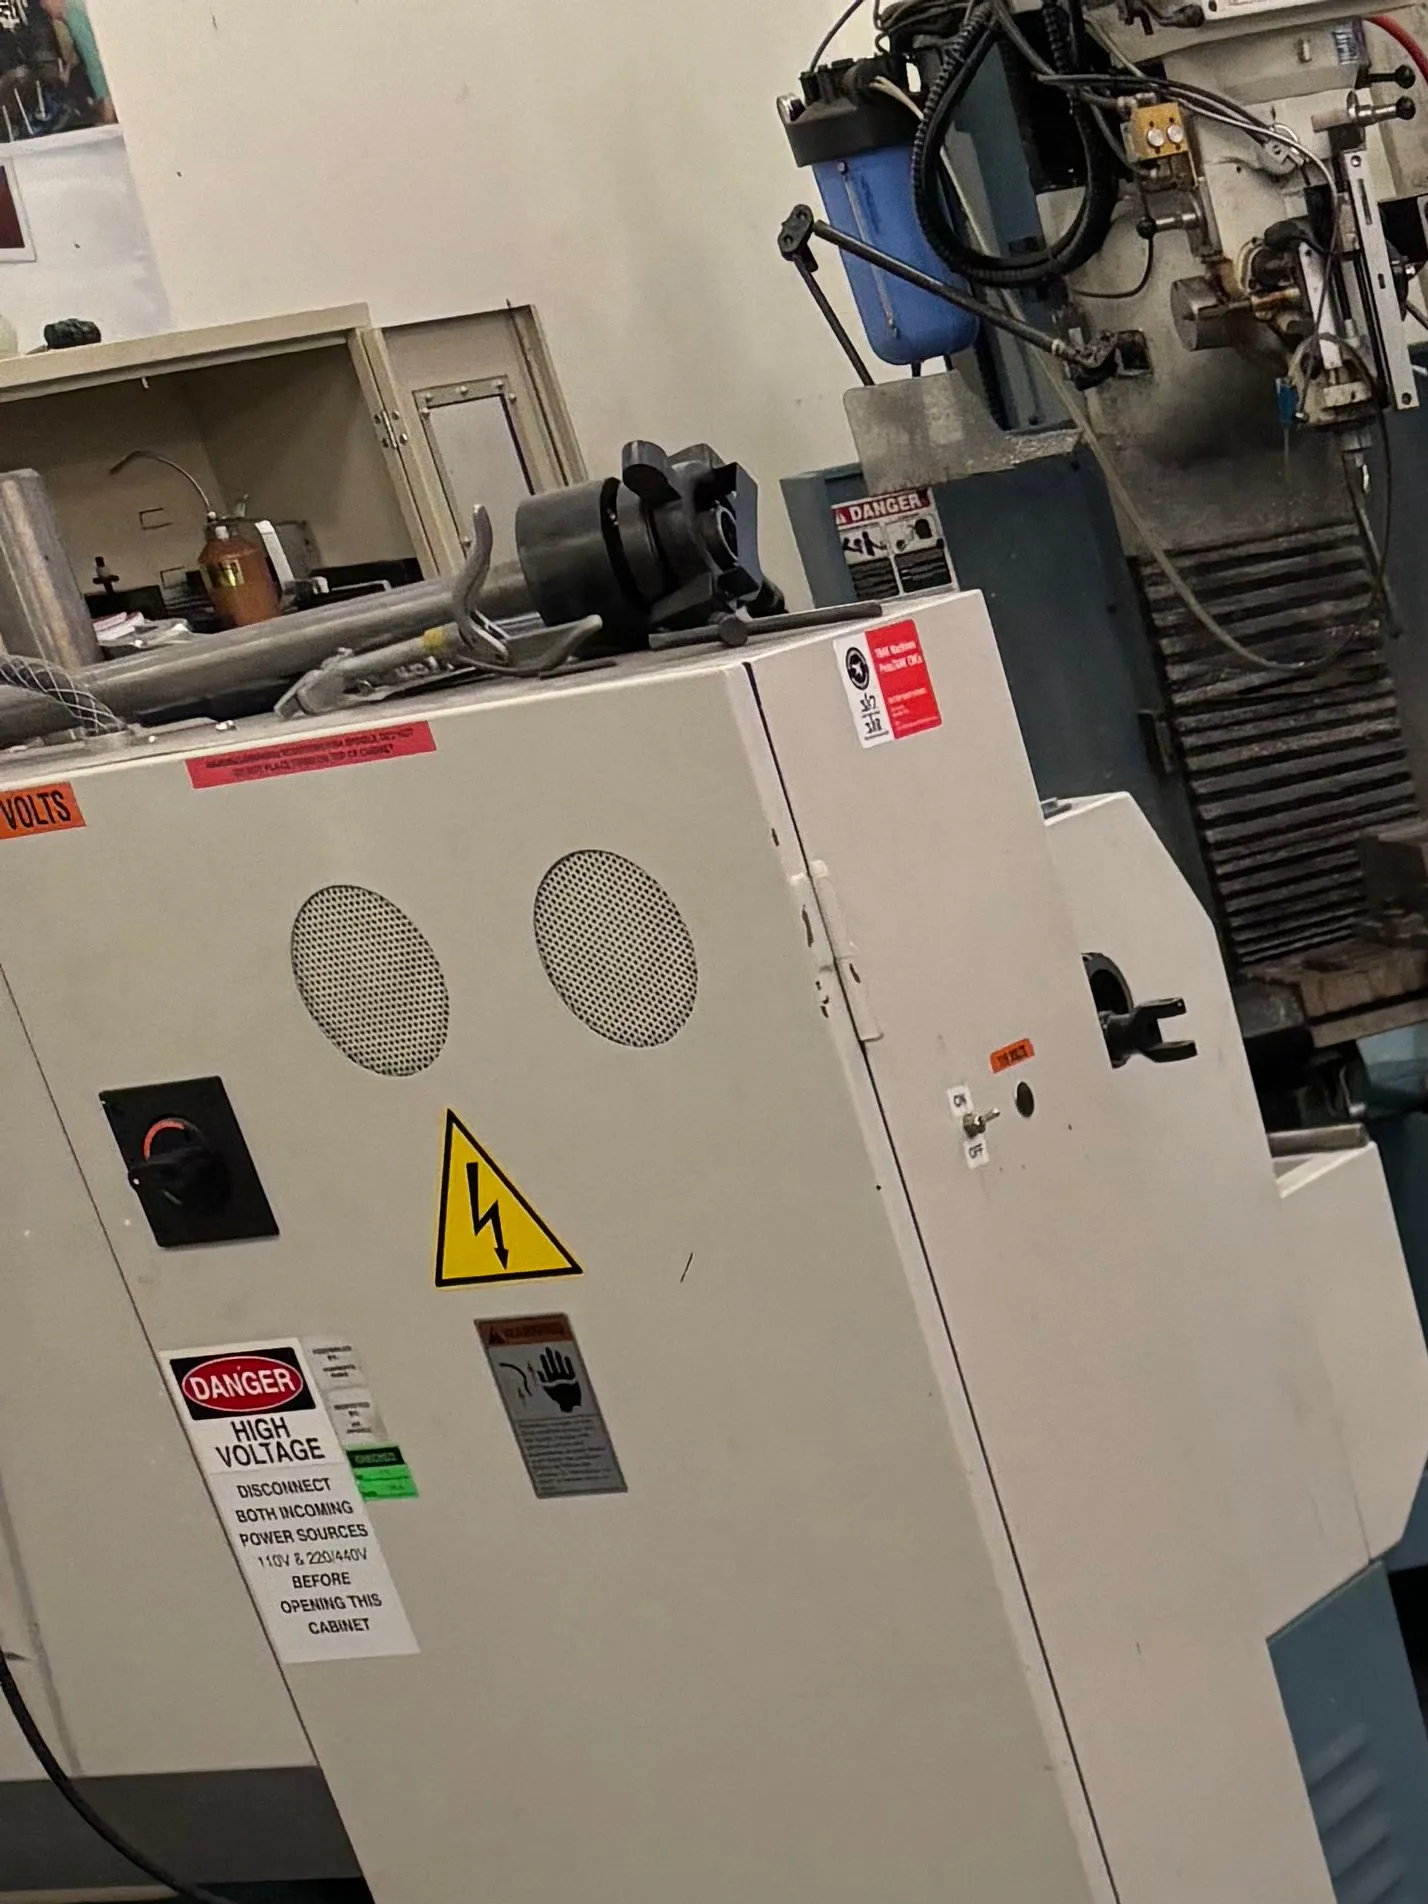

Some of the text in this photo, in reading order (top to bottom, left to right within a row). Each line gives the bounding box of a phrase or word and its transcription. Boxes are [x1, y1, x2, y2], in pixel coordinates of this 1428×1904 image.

[848, 493, 923, 525] DANGER
[0, 790, 71, 830] VOLTS
[189, 1368, 296, 1401] DANGER
[230, 1416, 292, 1443] HIGH
[215, 1437, 326, 1469] VOLTAGE
[236, 1477, 331, 1499] DISCONNECT
[235, 1500, 354, 1523] BOTH INCOMING
[239, 1523, 369, 1547] POWER SOURCES
[257, 1547, 368, 1568] 110V & 220/440V
[291, 1572, 352, 1589] BEFORE
[280, 1592, 383, 1614] OPENING THIS
[308, 1617, 371, 1635] CABINET
